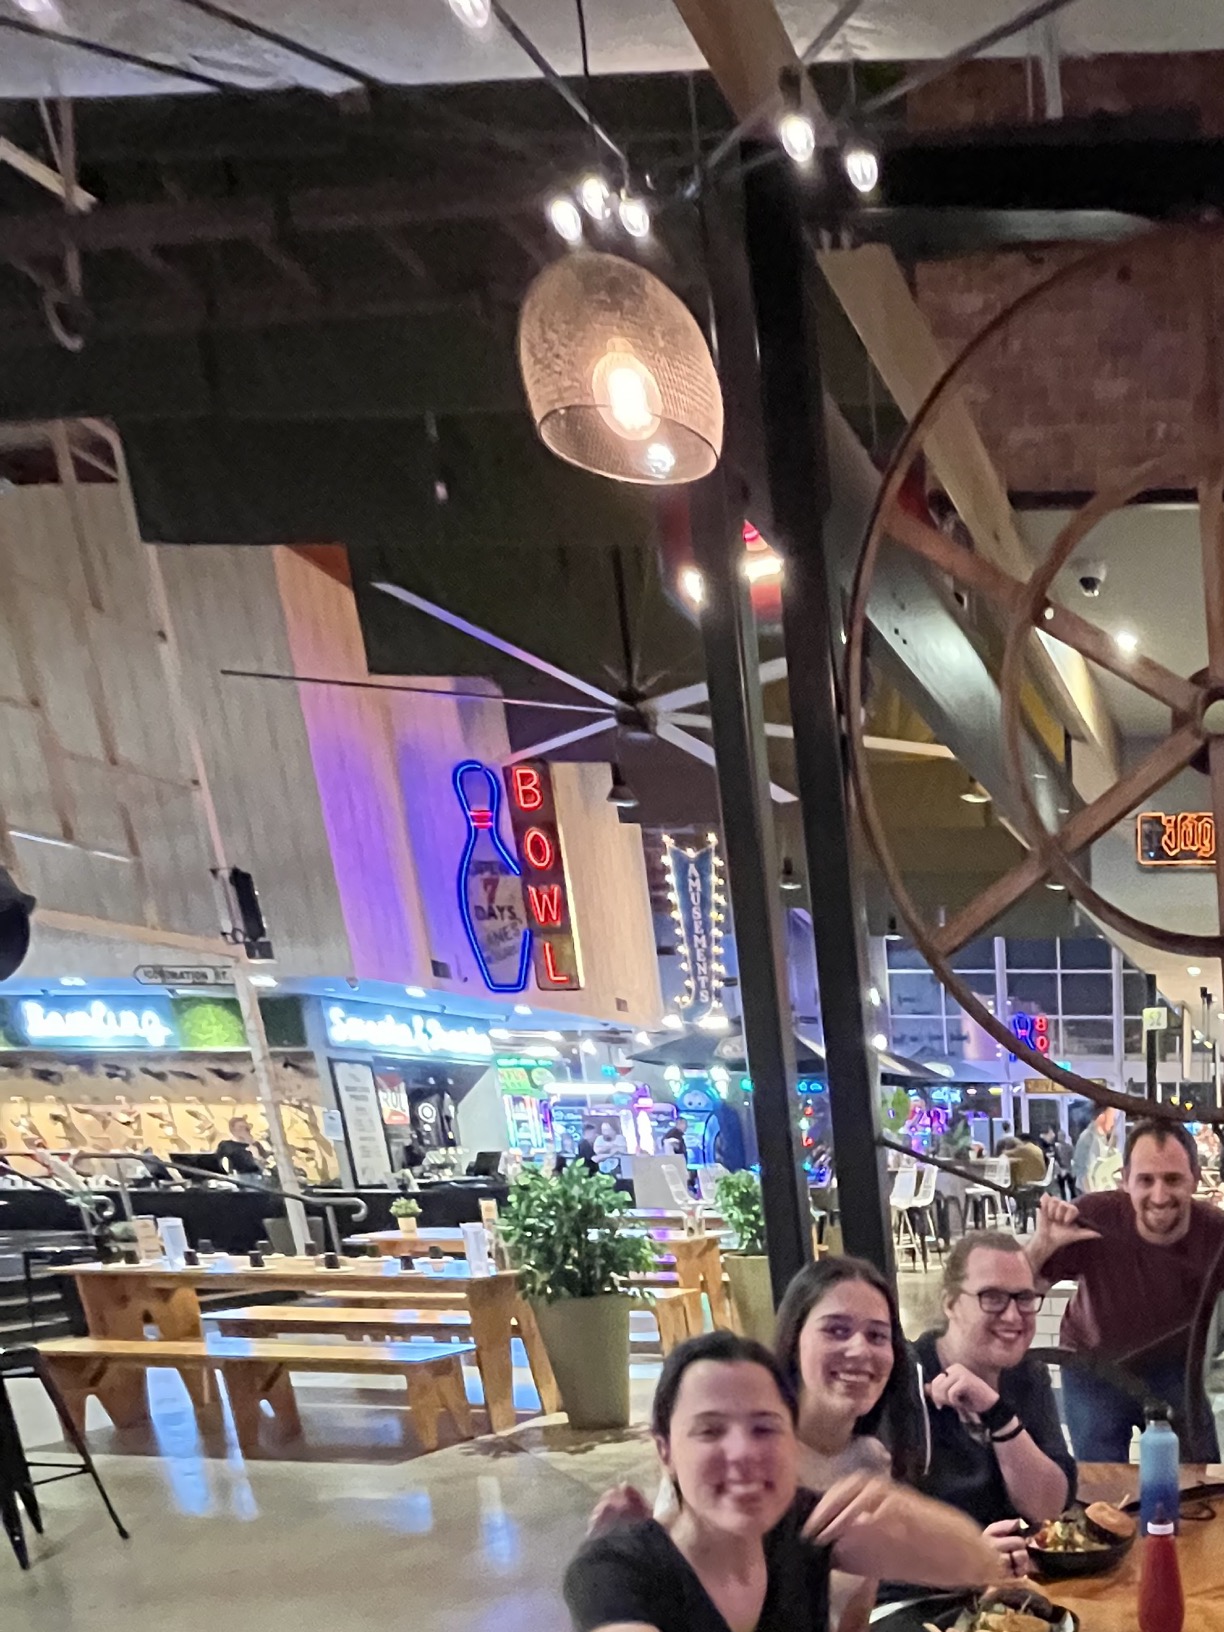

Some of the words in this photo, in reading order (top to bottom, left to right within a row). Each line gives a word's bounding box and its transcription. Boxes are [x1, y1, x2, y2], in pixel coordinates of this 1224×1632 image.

[483, 878, 500, 904] 7
[513, 766, 569, 984] BOWL
[688, 863, 710, 1003] AMUSEMENTS
